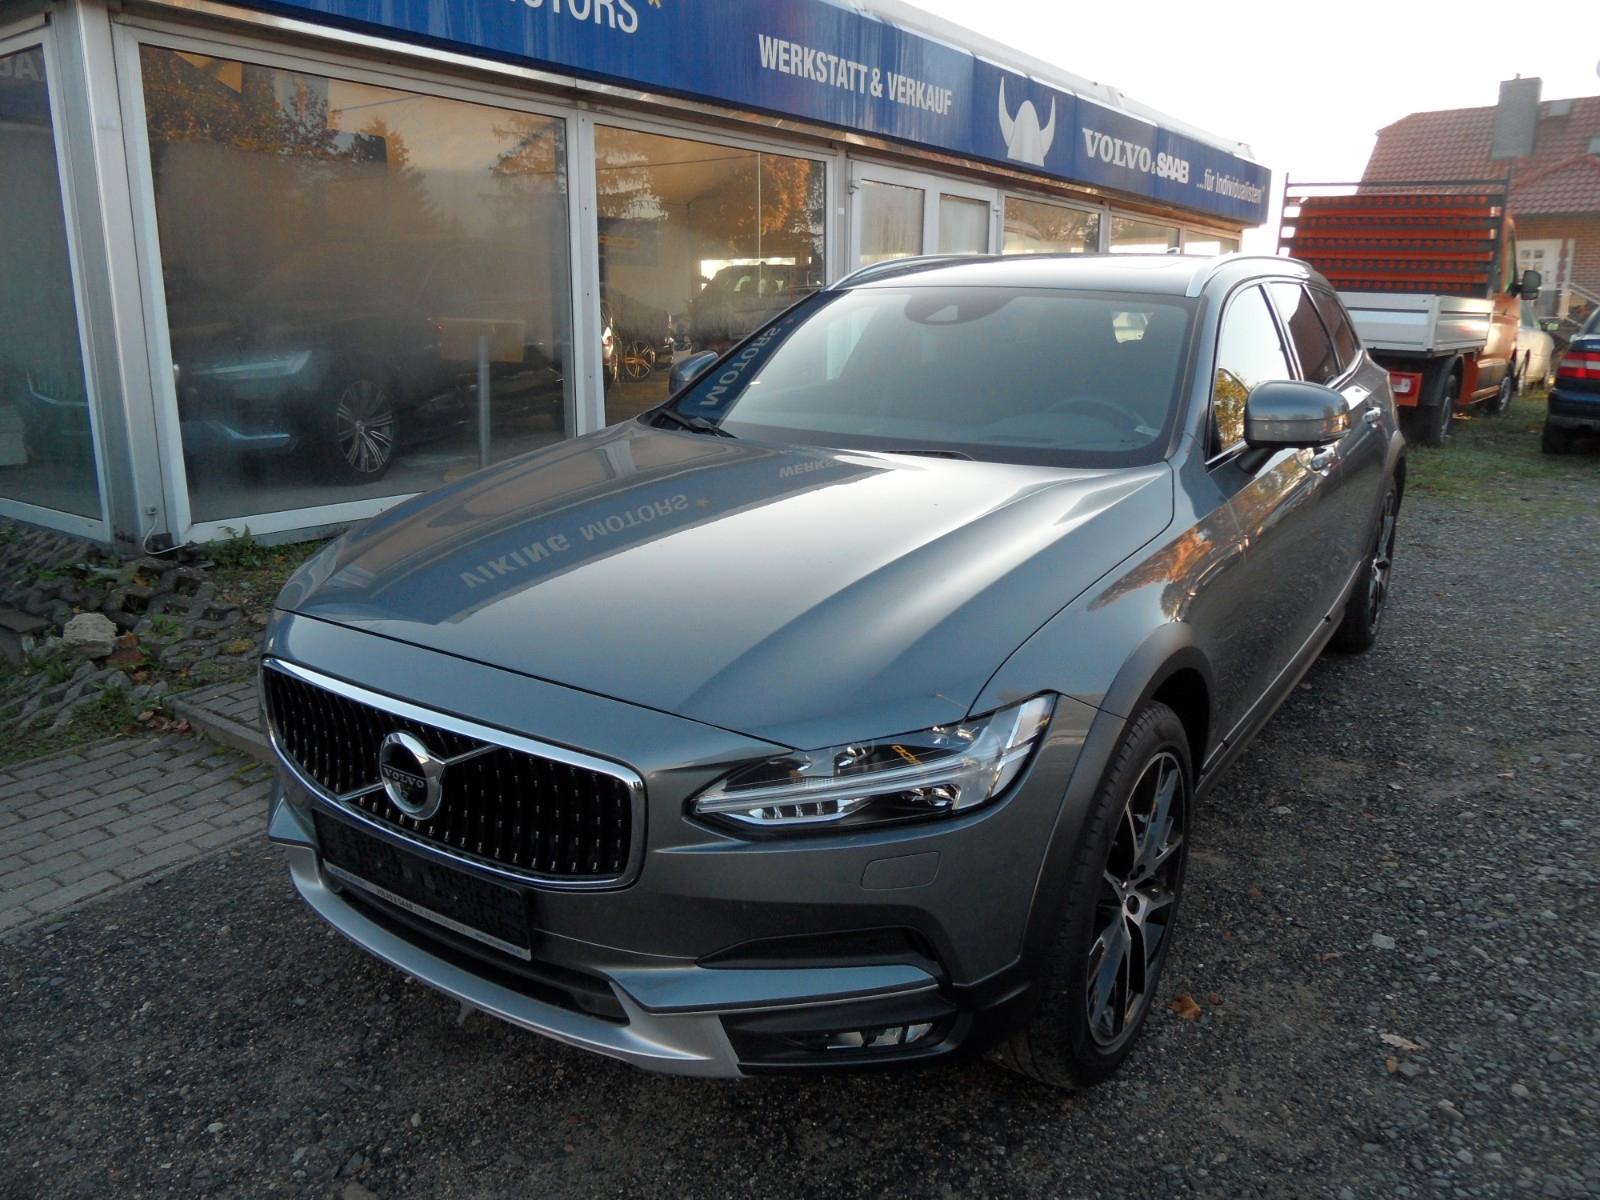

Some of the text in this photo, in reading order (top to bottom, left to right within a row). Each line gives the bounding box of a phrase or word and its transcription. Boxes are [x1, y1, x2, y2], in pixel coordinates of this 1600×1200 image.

[758, 33, 953, 116] WERKSTATT & VERKAUF
[1082, 127, 1151, 173] VOLVO
[1156, 152, 1190, 184] SAAB
[383, 767, 425, 789] VOLVO
